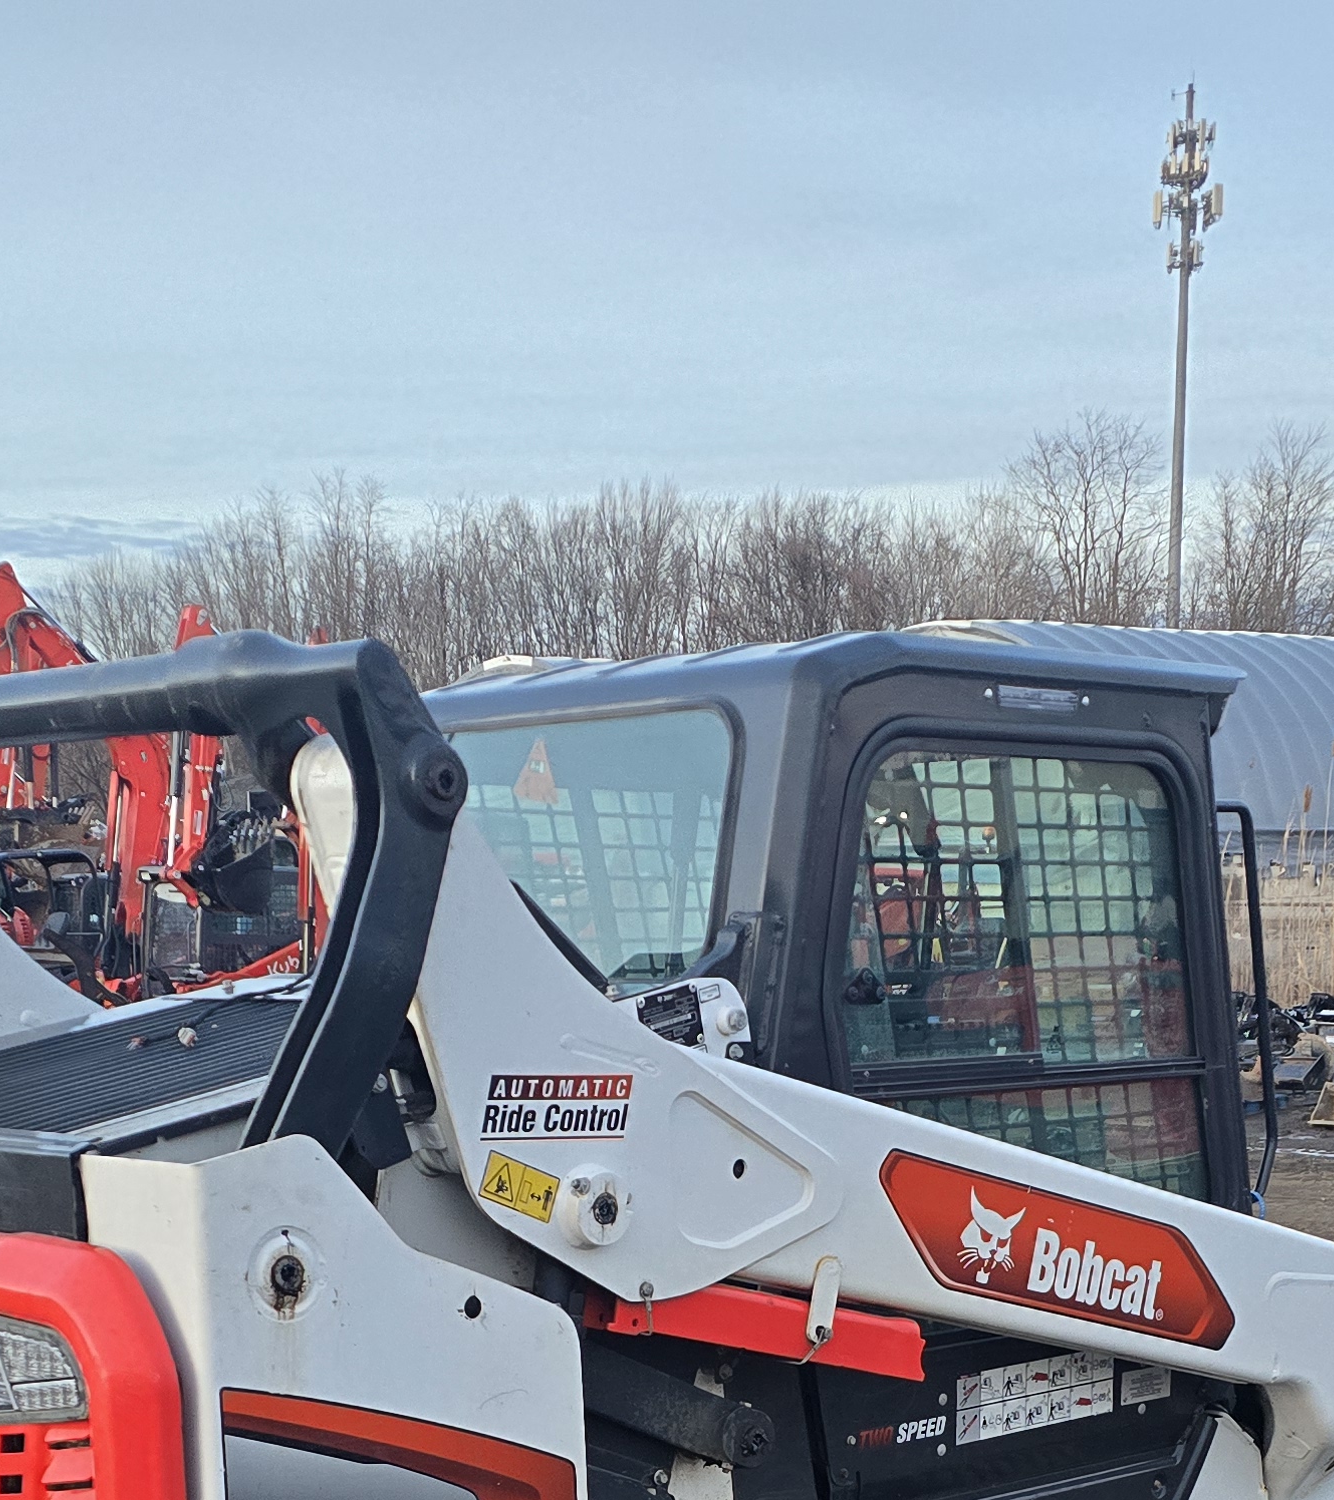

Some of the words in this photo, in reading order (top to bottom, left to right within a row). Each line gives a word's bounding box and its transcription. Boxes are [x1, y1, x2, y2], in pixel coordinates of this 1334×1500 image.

[267, 955, 300, 975] Kub
[493, 1079, 628, 1098] AUTOMATIC
[481, 1104, 537, 1133] Ride
[543, 1103, 629, 1132] Control
[1027, 1227, 1162, 1320] Bobcat
[859, 1426, 894, 1449] TWO
[896, 1415, 947, 1444] SPEED
